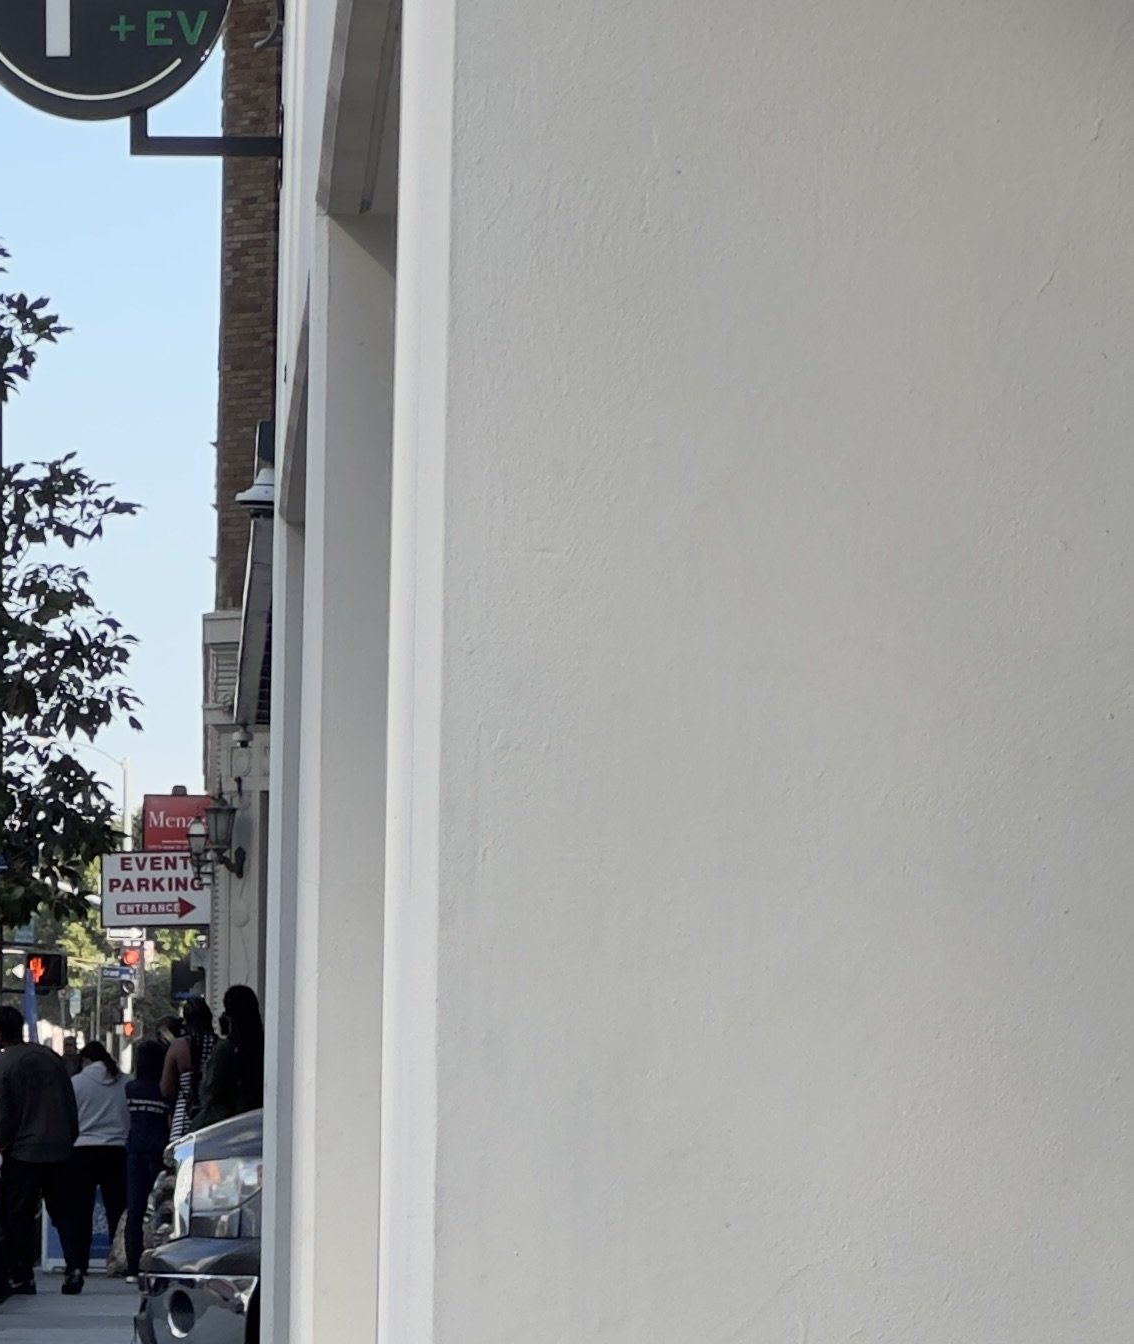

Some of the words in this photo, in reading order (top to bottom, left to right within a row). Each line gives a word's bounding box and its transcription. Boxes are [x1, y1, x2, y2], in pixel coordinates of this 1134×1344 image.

[120, 856, 191, 871] EVENT
[109, 876, 205, 892] PARKING
[119, 903, 181, 914] ENTRANCE
